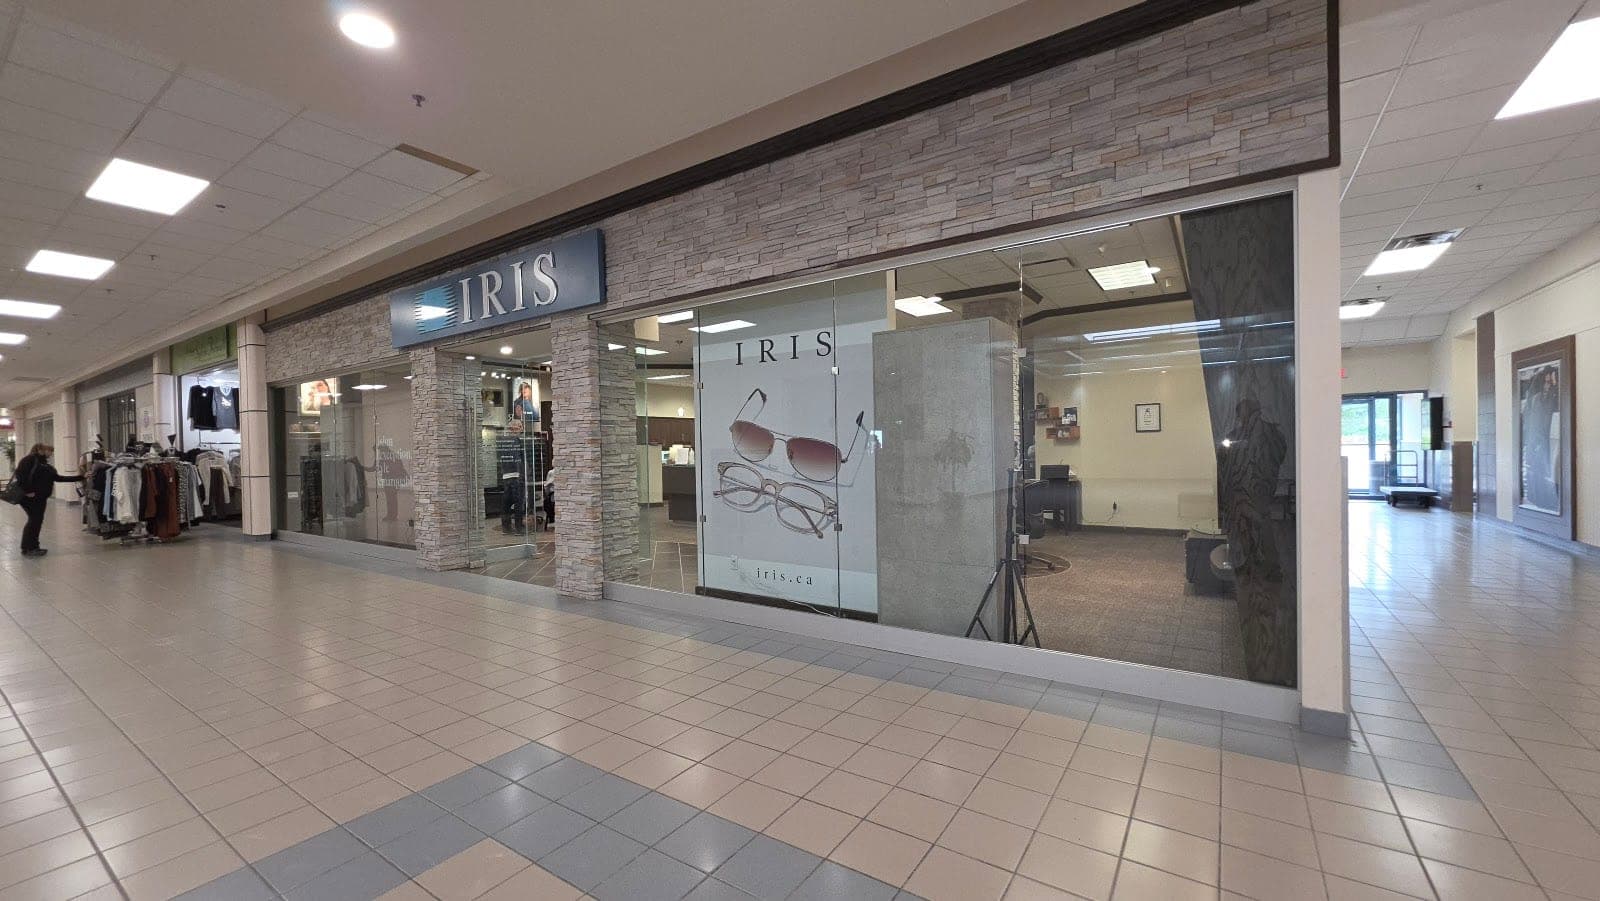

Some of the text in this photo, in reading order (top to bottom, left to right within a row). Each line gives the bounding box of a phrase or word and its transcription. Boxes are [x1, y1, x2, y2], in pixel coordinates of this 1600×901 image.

[458, 250, 558, 324] IRIS
[735, 331, 831, 365] IRIS
[757, 567, 812, 585] iris.ca
